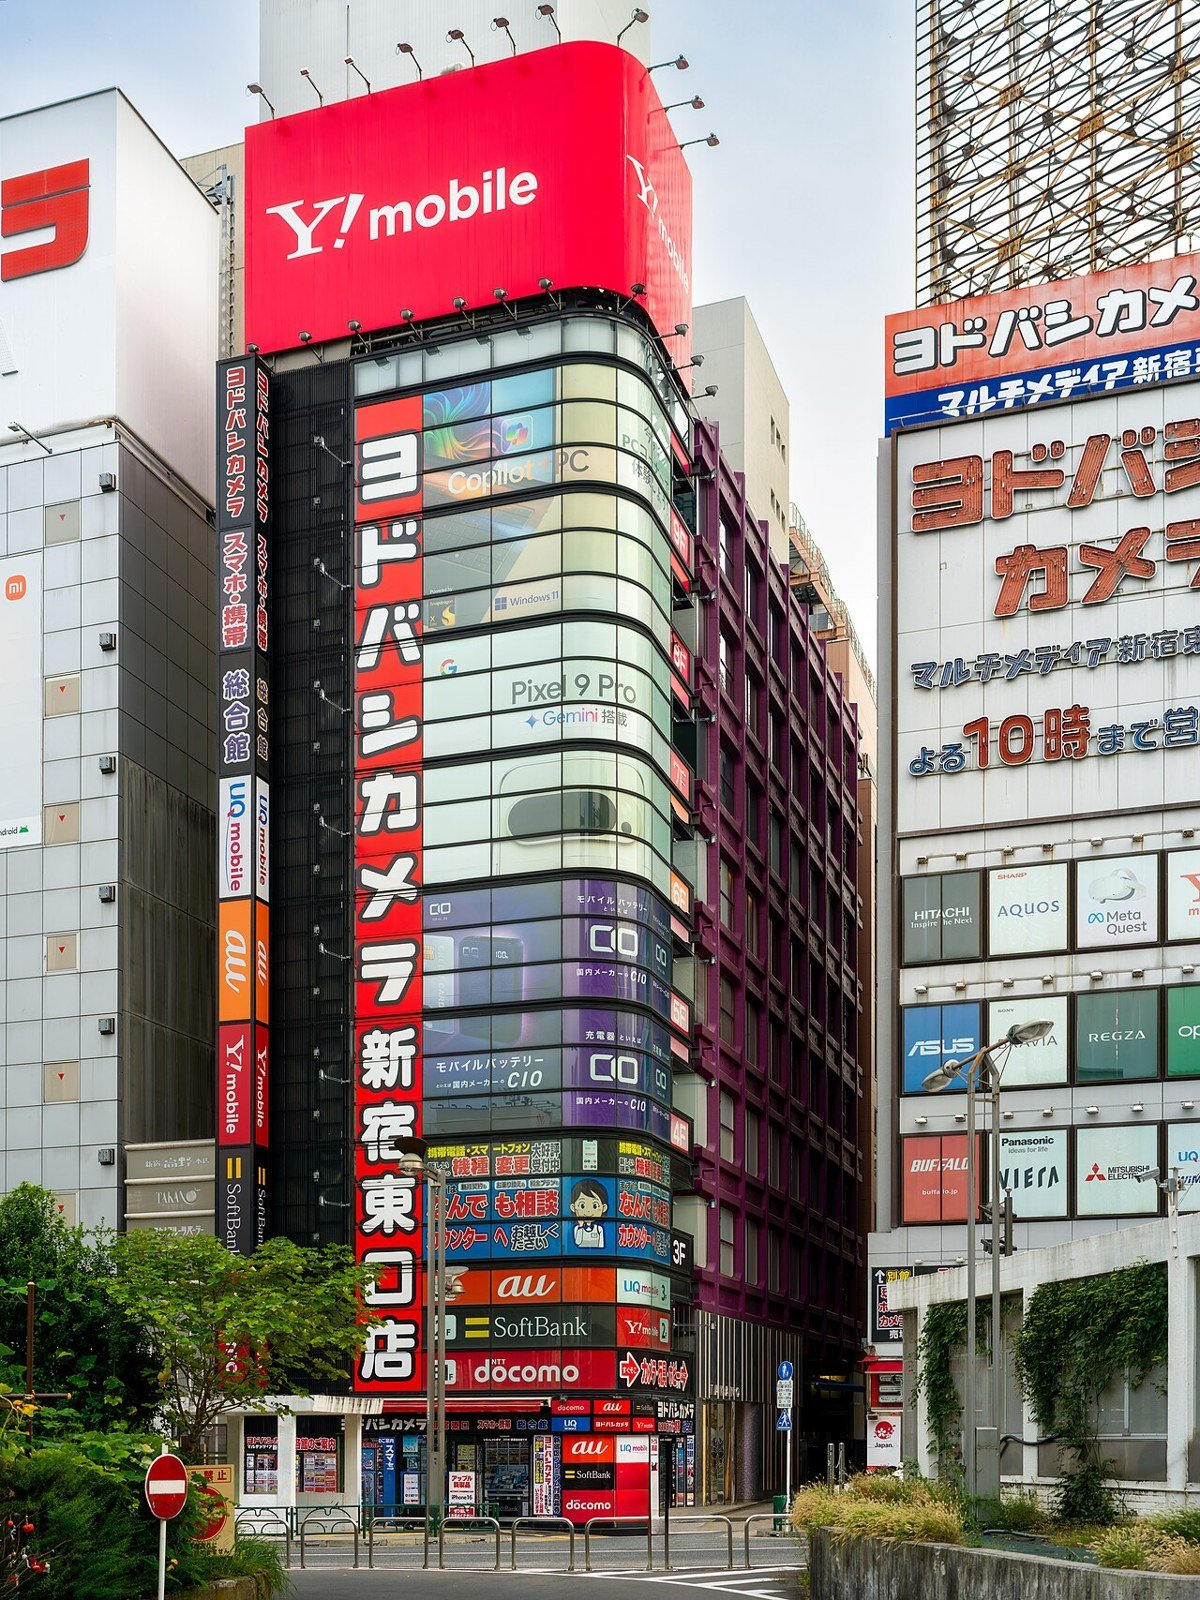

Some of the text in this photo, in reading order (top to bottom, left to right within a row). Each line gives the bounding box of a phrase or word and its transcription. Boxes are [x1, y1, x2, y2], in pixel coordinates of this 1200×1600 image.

[893, 276, 1199, 376] ヨドバシカメ
[225, 365, 247, 518] ヨドバシカメラ
[256, 367, 269, 523] ヨドバシカメラ
[447, 450, 589, 494] Copilot+ PC
[673, 518, 687, 551] 9F
[222, 532, 248, 648] スマホ・携帯
[510, 590, 559, 606] Windows 11
[512, 674, 637, 704] Pixel 9 Pro
[222, 668, 250, 764] 総合館
[543, 708, 598, 725] Gemini
[909, 703, 1200, 776] よる10時まで営
[673, 760, 687, 792] 7F
[258, 794, 268, 826] UQ
[0, 826, 18, 836] droid
[227, 782, 246, 891] UQ mobile
[673, 880, 687, 912] 6F
[357, 430, 422, 1382] ヨドバシカメラ新宿東口店
[914, 906, 970, 921] HITACHI
[997, 900, 1060, 918] AQUOS
[911, 920, 938, 929] Inspire
[954, 917, 973, 925] Next
[1107, 910, 1141, 922] Meta
[1107, 921, 1147, 935] Quest
[225, 929, 247, 993] au
[257, 939, 267, 986] au
[673, 997, 687, 1032] 5F
[1088, 1030, 1146, 1042] REGZA
[908, 1038, 974, 1057] ASUS
[436, 1055, 544, 1073] モバイルバッテリー
[673, 1120, 687, 1147] 4F
[1001, 1136, 1054, 1147] Panasonic
[531, 1142, 560, 1159] 大好評
[1037, 1145, 1048, 1153] life
[1178, 1151, 1199, 1162] UQ
[451, 1155, 530, 1178] 機種変更
[531, 1158, 560, 1174] 受付中
[1108, 1165, 1150, 1173] MITSUBISHI
[1108, 1172, 1138, 1180] ELECT
[257, 1188, 266, 1246] SoftBan
[511, 1223, 559, 1238] お越しく
[673, 1239, 686, 1265] 3F
[498, 1274, 556, 1298] au
[624, 1280, 659, 1296] UQ mobile
[494, 1316, 588, 1338] SoftBank
[474, 1359, 579, 1383] docomo
[603, 1402, 622, 1412] au
[657, 1401, 694, 1419] ヨドバシカメラ
[564, 1419, 577, 1427] UQ
[571, 1440, 608, 1455] au
[620, 1443, 632, 1453] UQ
[544, 1436, 552, 1485] ヨドバシカメラ
[577, 1470, 611, 1480] SoftBank
[566, 1500, 611, 1510] docomo
